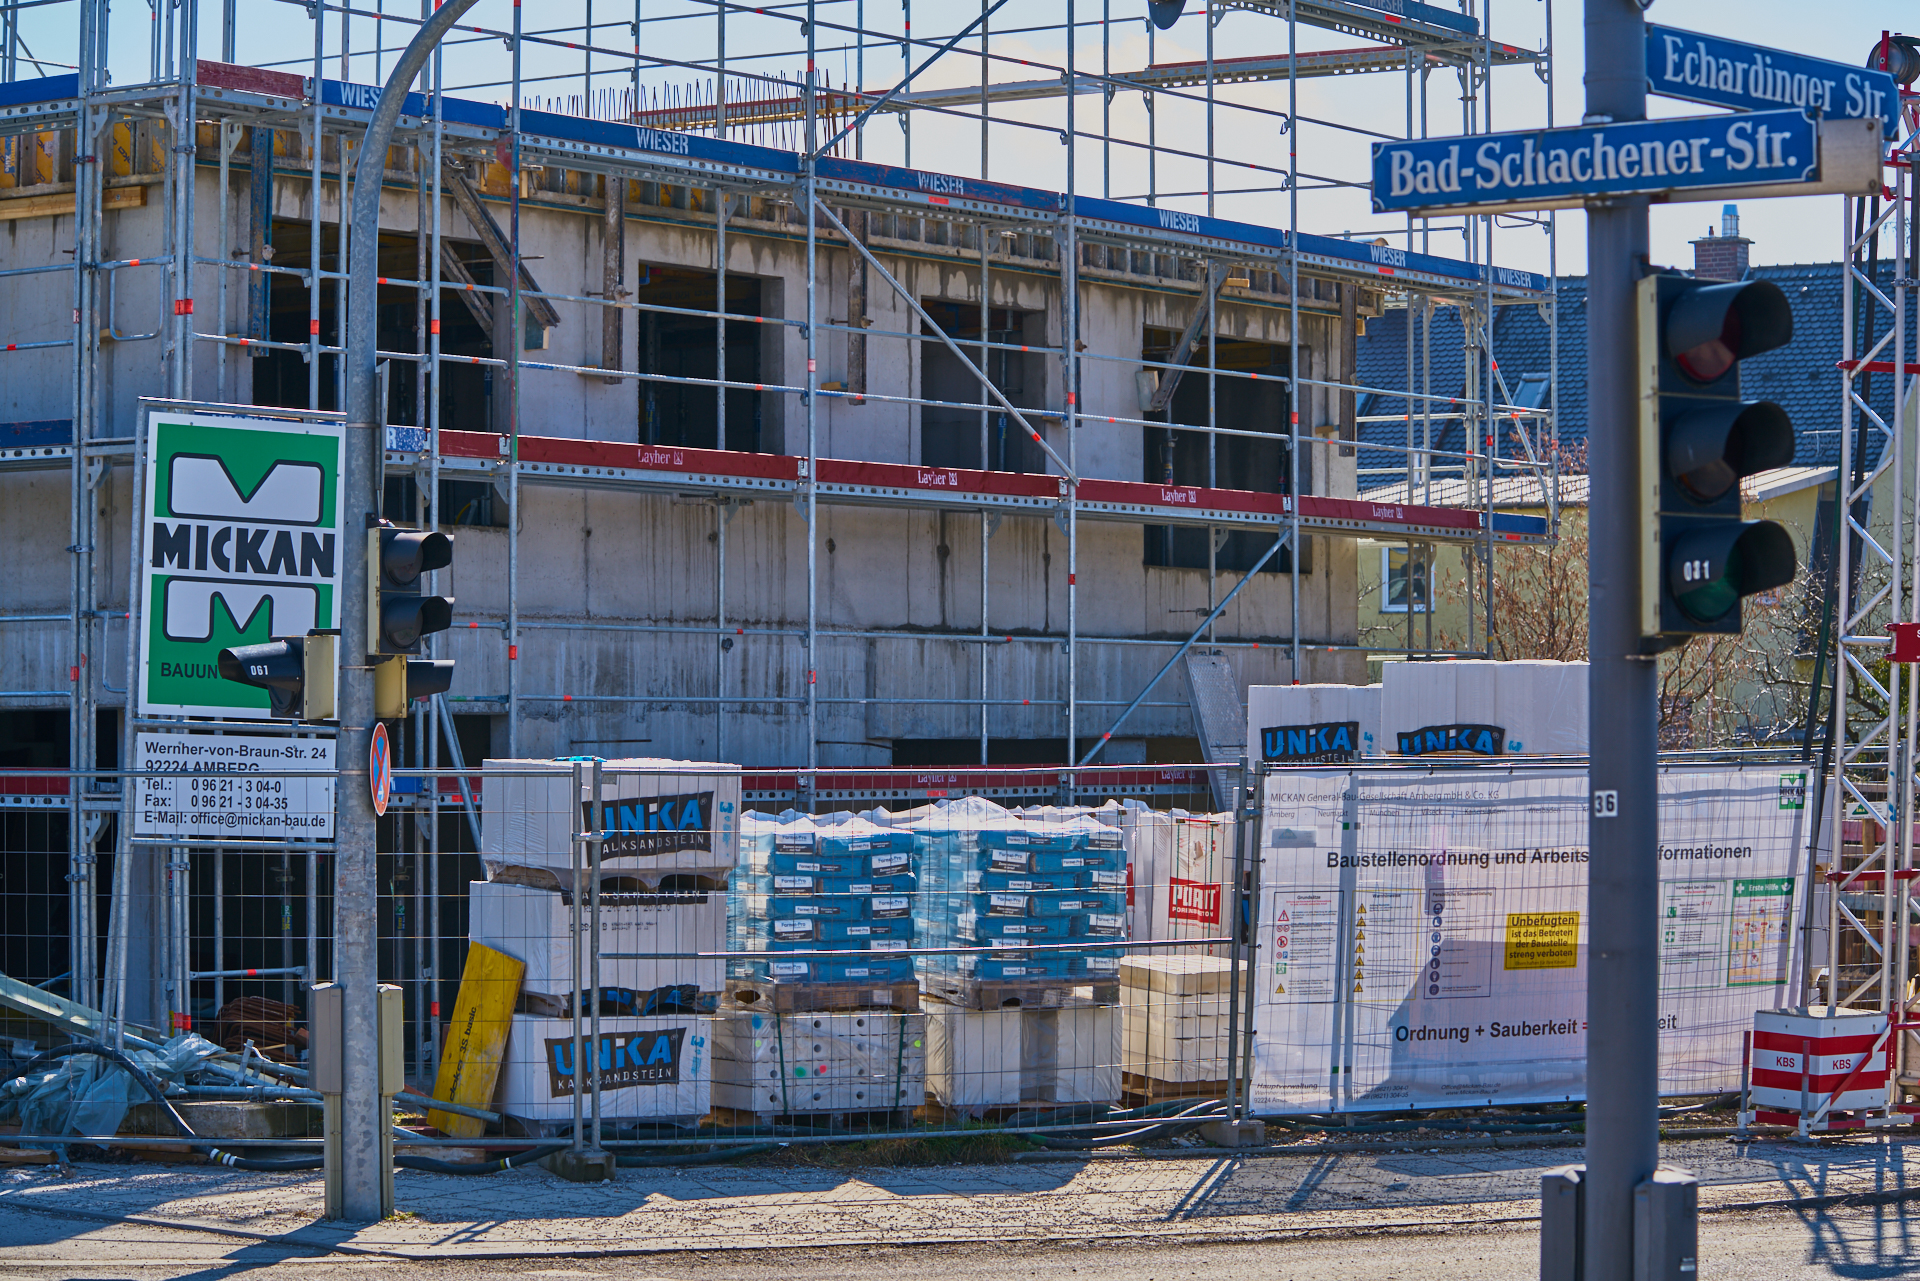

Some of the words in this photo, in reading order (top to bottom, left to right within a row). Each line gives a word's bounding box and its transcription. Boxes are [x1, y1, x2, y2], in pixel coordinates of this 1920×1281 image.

[1662, 34, 1836, 112] Echardinger
[1844, 73, 1890, 123] Str.
[340, 83, 379, 107] WIES
[636, 127, 690, 155] WIESER
[1389, 120, 1798, 197] Bad-Schachener-Str.
[917, 171, 965, 196] WIESER
[1159, 208, 1200, 233] WIESER
[1370, 245, 1406, 267] WIESER
[1497, 268, 1532, 288] WIESER
[638, 449, 671, 465] Layher
[918, 470, 947, 487] Layher
[1161, 489, 1187, 504] Layher
[1372, 505, 1394, 521] Layher
[152, 522, 335, 578] MICKAN
[161, 663, 218, 679] BAUUN
[145, 741, 307, 759] Wernher-von-Braun-Str.
[311, 747, 327, 759] 24
[145, 760, 188, 772] 92224
[193, 761, 260, 772] AMBERG
[145, 778, 172, 791] Tel.:
[191, 779, 199, 791] 0
[202, 779, 217, 791] 96
[220, 780, 234, 792] 21
[245, 780, 253, 793] 3
[256, 780, 282, 793] 04-0
[145, 794, 172, 807] Fax:
[191, 795, 199, 807] 0
[201, 795, 216, 808] 96
[219, 796, 233, 808] 21
[245, 797, 252, 809] 3
[256, 797, 288, 810] 04-35
[1270, 793, 1306, 802] MICKAN
[1409, 790, 1441, 803] Amberg
[1443, 790, 1463, 800] mbH
[1465, 791, 1472, 799] &
[1473, 790, 1487, 800] Co.
[1596, 795, 1615, 813] 36
[144, 811, 187, 824] E-Mail:
[190, 812, 326, 828] office@mickan-bau.de
[1269, 810, 1295, 819] Amberg
[1317, 809, 1348, 818] Neumarkt
[602, 835, 705, 855] ALKSANDSTEIN
[1327, 851, 1490, 869] Baustellenordnung
[1495, 849, 1526, 866] und
[1531, 848, 1589, 864] Arbeits
[1658, 843, 1752, 861] formationen
[1749, 884, 1764, 892] Erste
[1172, 885, 1216, 910] PORIT
[1511, 915, 1575, 928] Unbefugten
[1511, 929, 1522, 938] ist
[1523, 929, 1537, 938] das
[1538, 928, 1573, 937] Betreten
[1515, 939, 1529, 948] der
[1531, 938, 1568, 948] Baustelle
[1509, 951, 1535, 960] streng
[1536, 949, 1573, 958] verboten
[1396, 1023, 1470, 1043] Ordnung
[1475, 1026, 1485, 1036] +
[1490, 1018, 1578, 1038] Sauberkeit
[1657, 1013, 1677, 1030] eit
[450, 1059, 464, 1102] doka
[464, 1006, 478, 1037] basic
[1776, 1056, 1795, 1069] KBS
[1832, 1058, 1851, 1071] KBS
[1256, 1082, 1318, 1091] Hauptverwaltung
